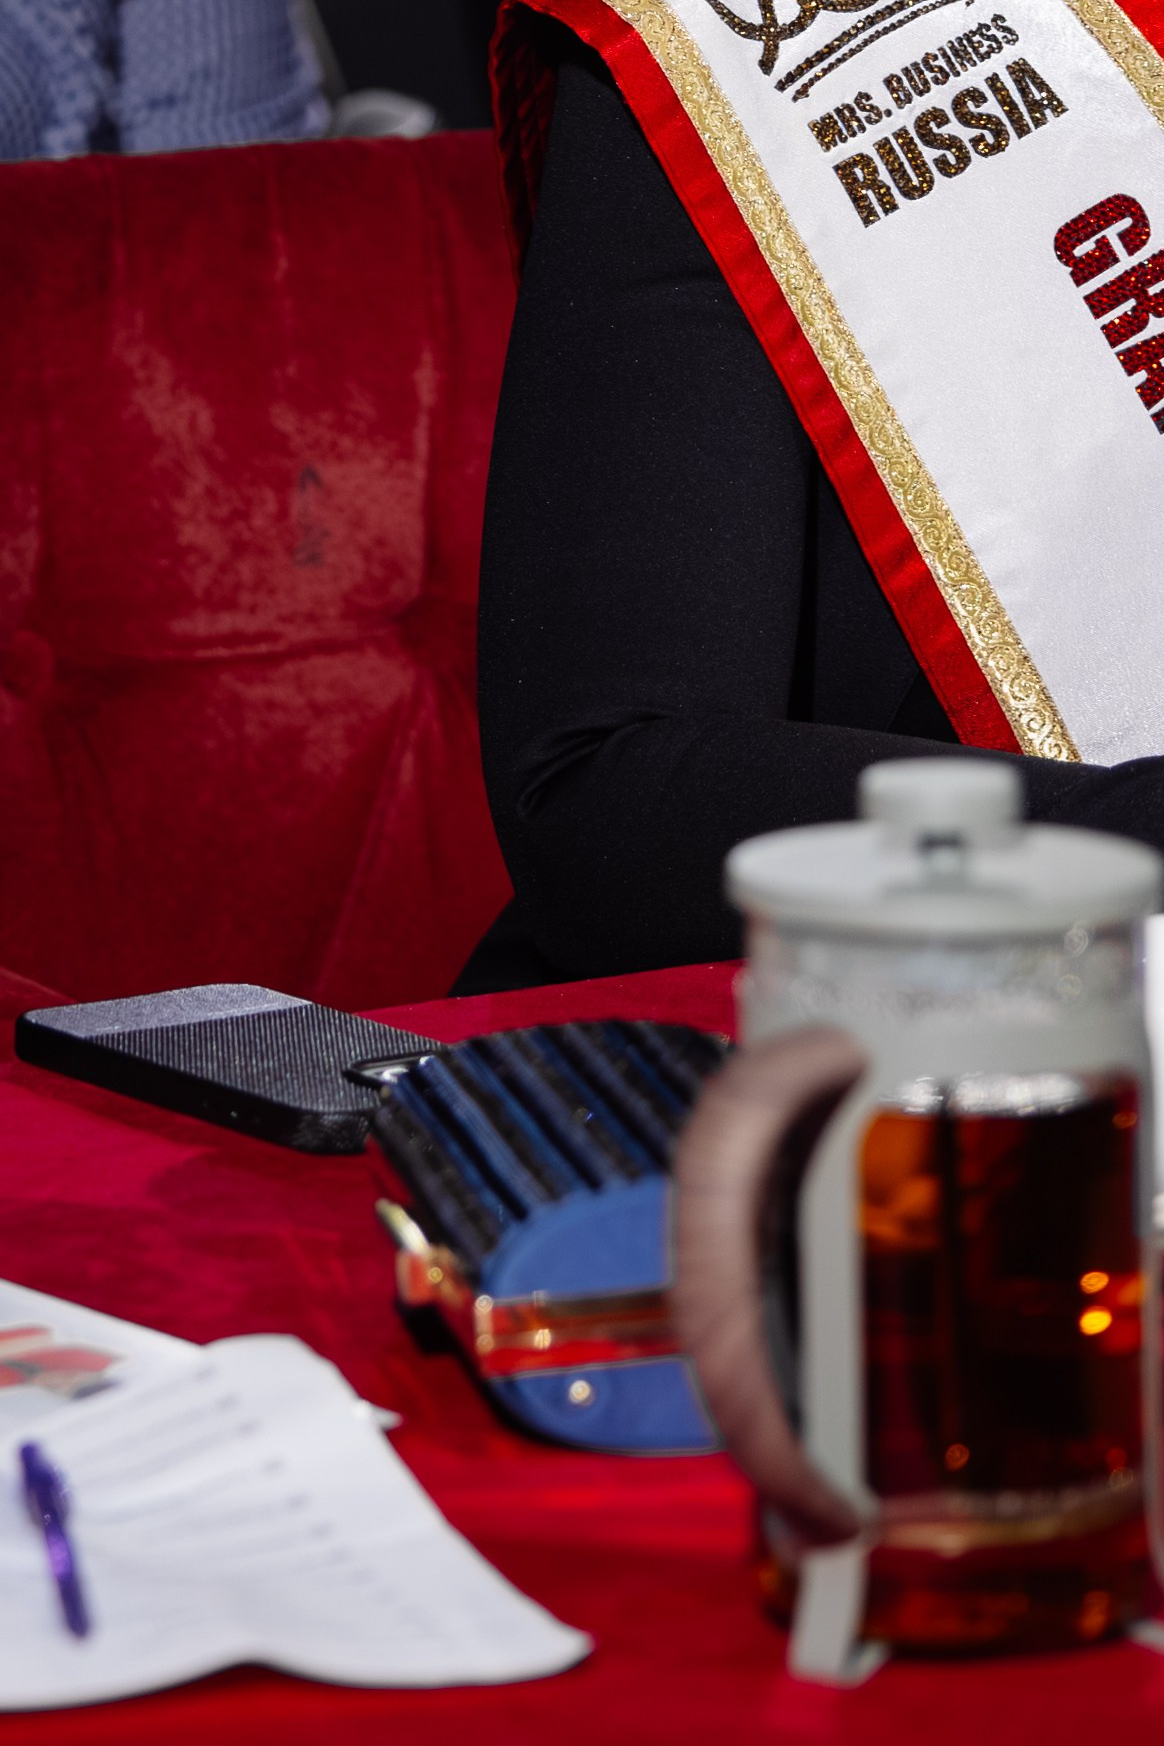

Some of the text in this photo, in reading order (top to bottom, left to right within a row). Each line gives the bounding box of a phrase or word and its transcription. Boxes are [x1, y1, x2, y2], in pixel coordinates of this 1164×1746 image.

[808, 13, 1020, 153] MRS. BUSINESS
[832, 57, 1069, 229] RUSSIA
